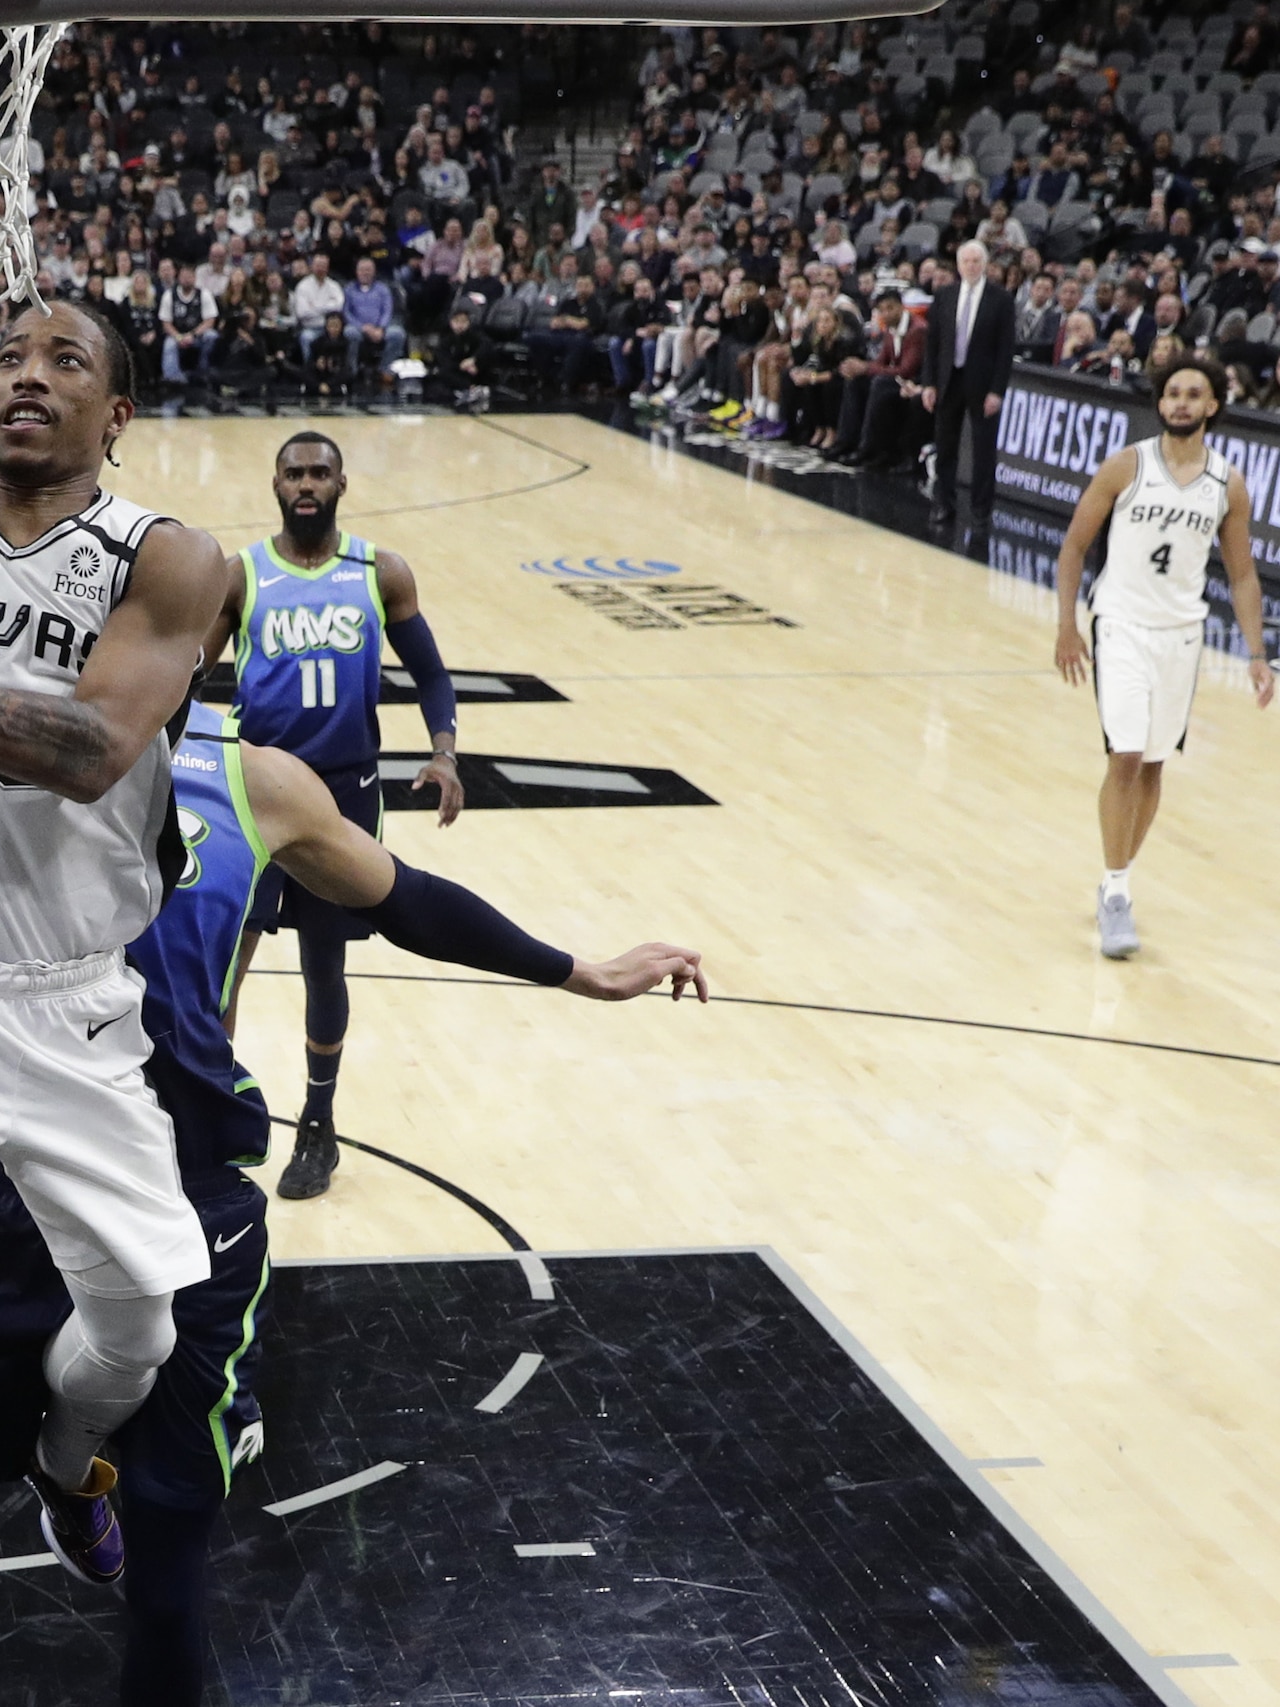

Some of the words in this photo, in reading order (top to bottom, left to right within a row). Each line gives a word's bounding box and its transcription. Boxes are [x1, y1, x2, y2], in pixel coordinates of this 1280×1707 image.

[995, 386, 1129, 477] DWEISER
[994, 462, 1041, 493] COPPER
[1041, 476, 1081, 504] LAGER
[1130, 505, 1215, 535] SPURS
[1148, 542, 1174, 575] 4
[52, 572, 106, 603] Frost
[331, 569, 365, 583] chime
[261, 604, 366, 658] MAVS
[298, 658, 336, 709] 11
[171, 752, 218, 772] hime
